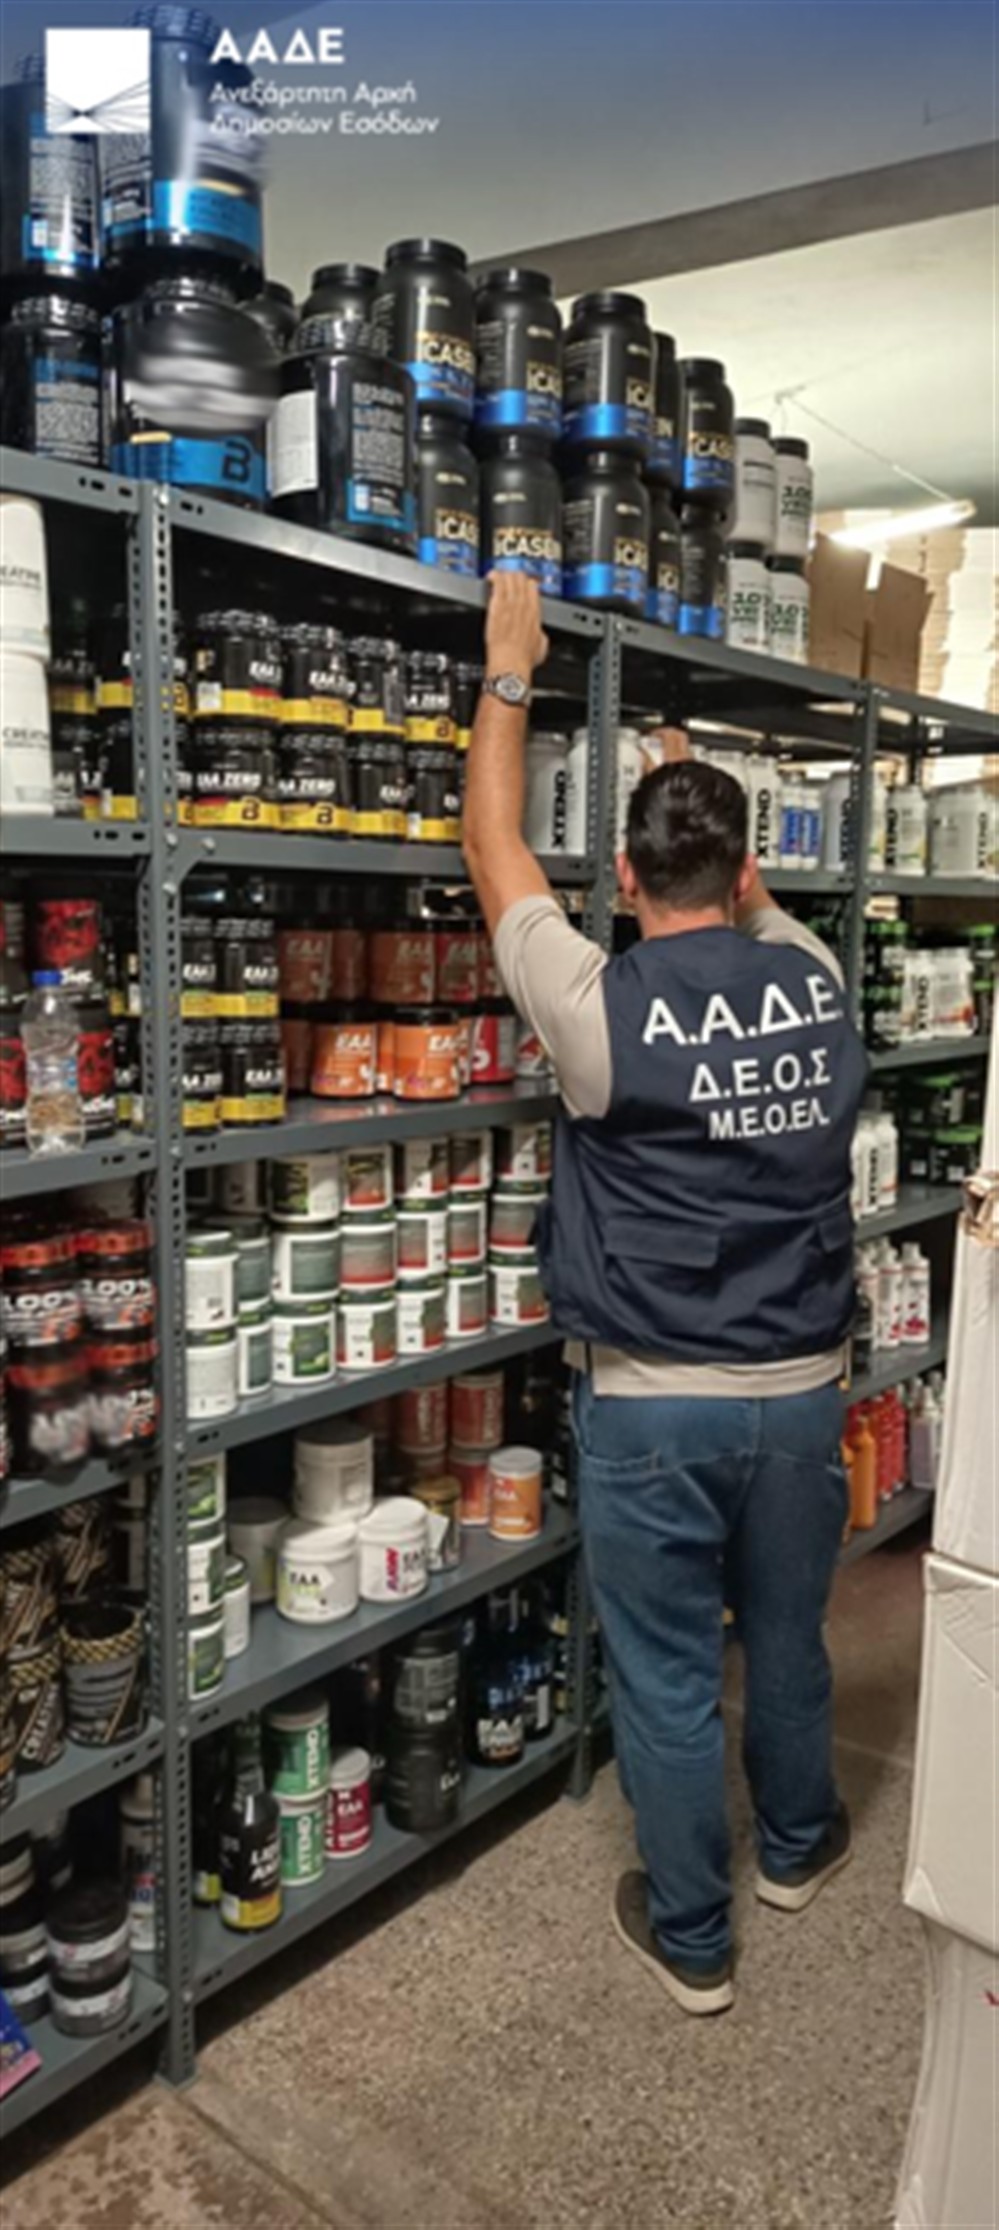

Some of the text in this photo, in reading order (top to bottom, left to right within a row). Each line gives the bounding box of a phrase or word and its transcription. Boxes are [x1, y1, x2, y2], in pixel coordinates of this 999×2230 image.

[552, 769, 567, 848] XTEND
[756, 788, 770, 858] XTEND
[885, 808, 898, 867] XTEND
